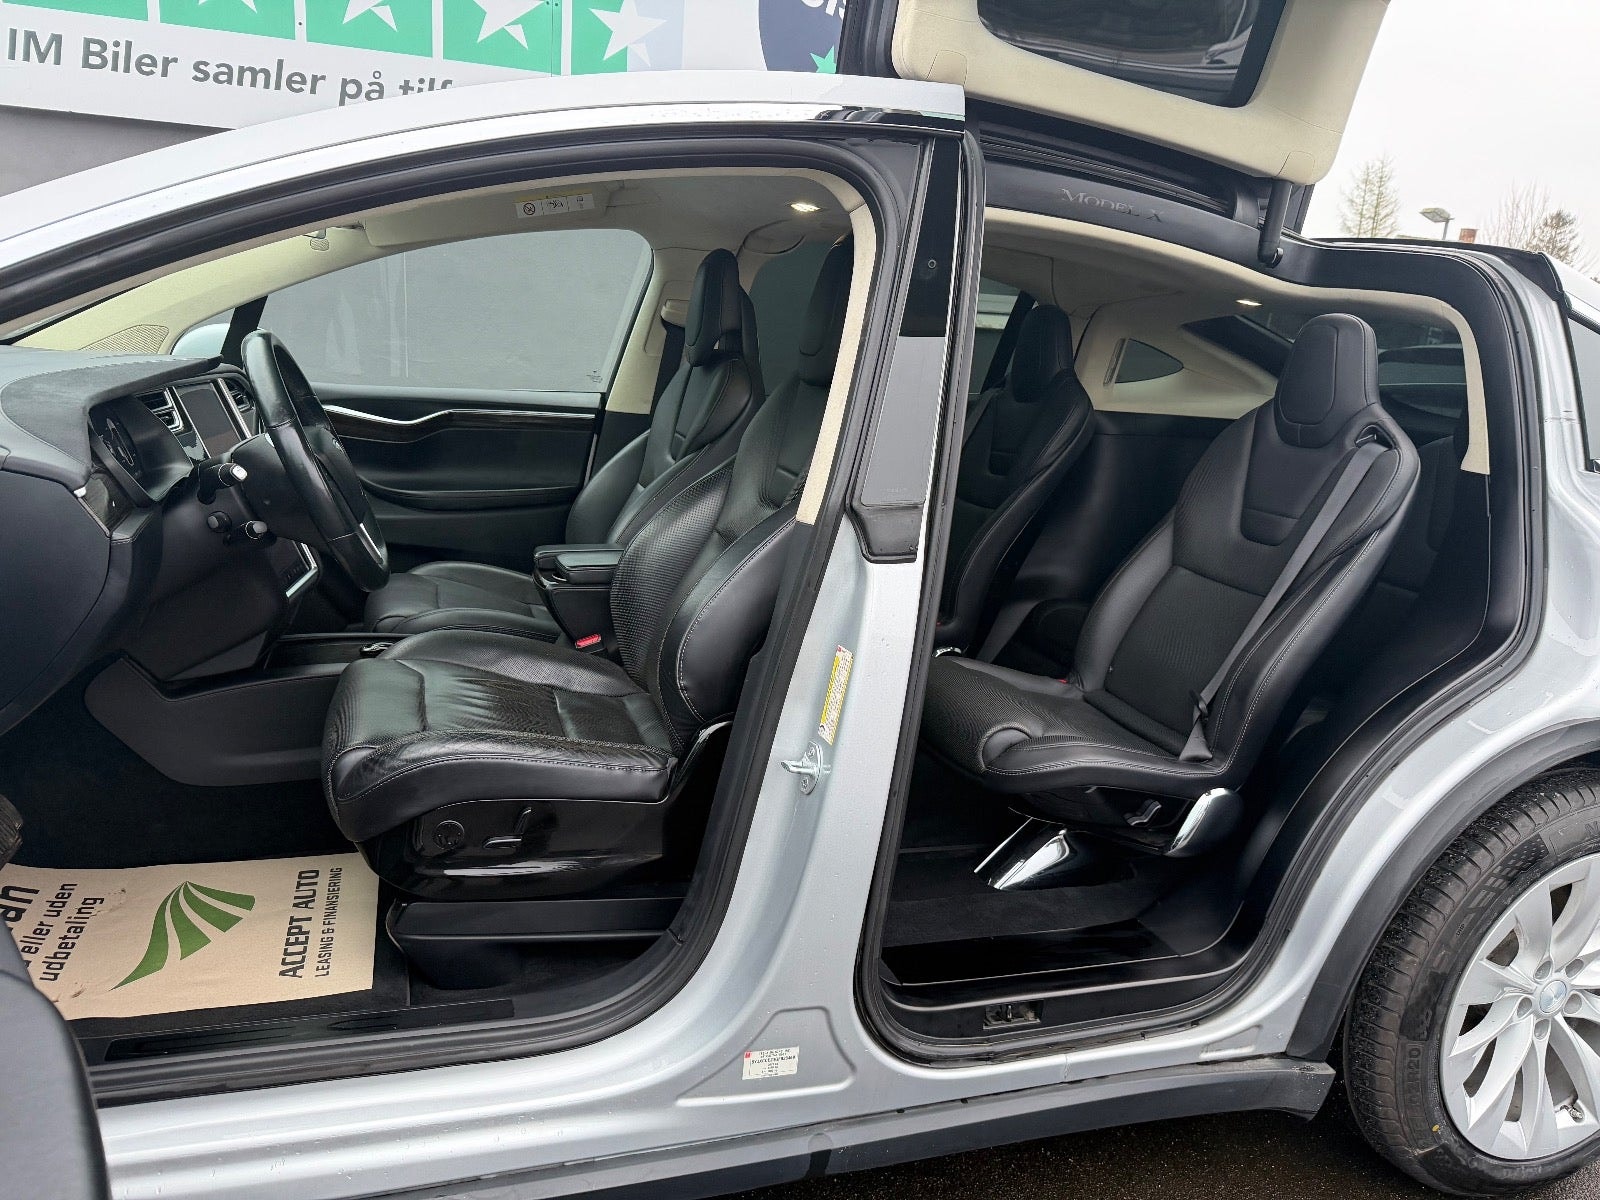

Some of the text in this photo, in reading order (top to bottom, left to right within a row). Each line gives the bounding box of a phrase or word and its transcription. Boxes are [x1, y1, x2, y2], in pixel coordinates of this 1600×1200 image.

[8, 28, 63, 66] IM
[81, 37, 178, 79] Biler
[191, 58, 326, 95] samler
[338, 70, 386, 106] på
[19, 883, 78, 955] eller uden
[39, 897, 105, 982] udbetaling
[278, 869, 320, 979] ACCEPT AUTO
[314, 867, 343, 978] LEASING & FINANSIERING
